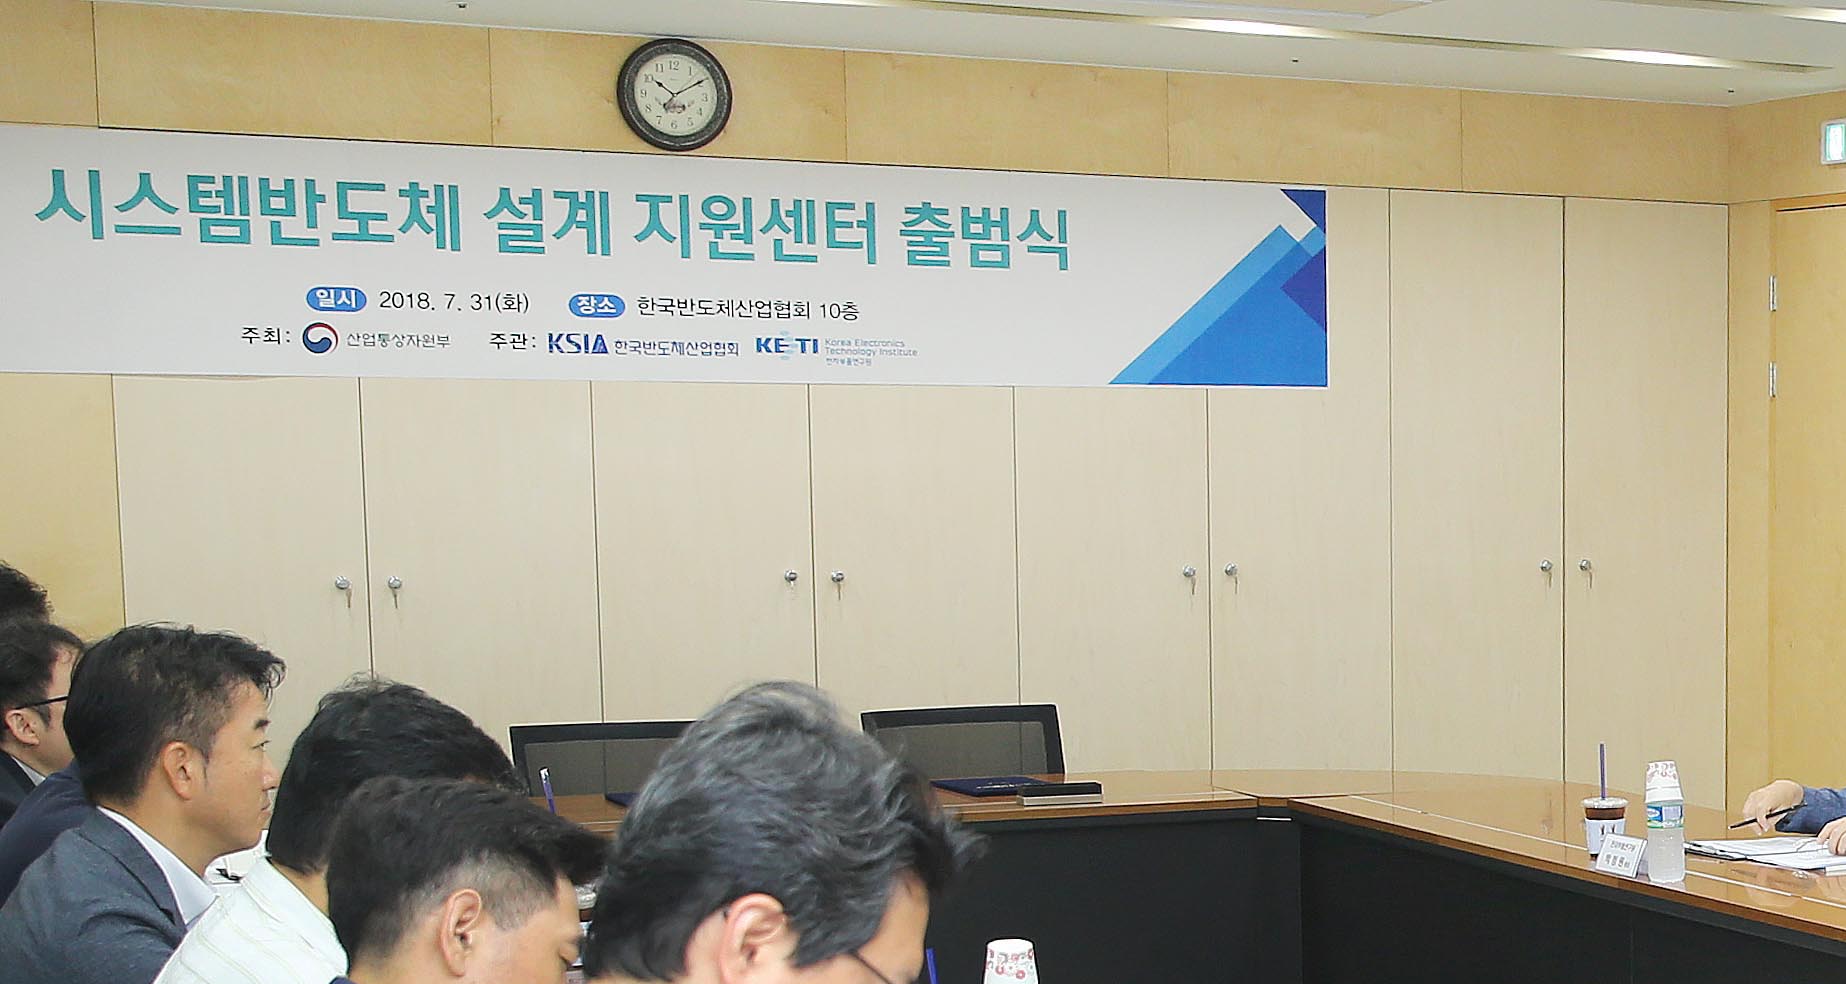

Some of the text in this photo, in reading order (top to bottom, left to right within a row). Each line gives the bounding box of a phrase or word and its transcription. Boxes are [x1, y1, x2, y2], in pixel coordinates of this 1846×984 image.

[655, 63, 664, 73] 11
[668, 60, 680, 71] 12
[34, 168, 1071, 271] 시스템반도체 설계 지원센터 출범식
[315, 288, 358, 308] 일시
[379, 291, 529, 313] 2018. 7. 31(화)
[577, 296, 617, 314] 장소
[637, 296, 860, 321] 한국반도체산업협회 10층
[241, 327, 291, 345] 주최:
[346, 333, 451, 348] 산업통상자원부
[489, 333, 536, 350] 주관:
[548, 333, 609, 354] KSIA
[825, 338, 905, 348] Korea Electronics
[614, 339, 739, 356] 한국반도체산업협회
[755, 337, 819, 354] KETI
[826, 347, 918, 357] Technology Institute
